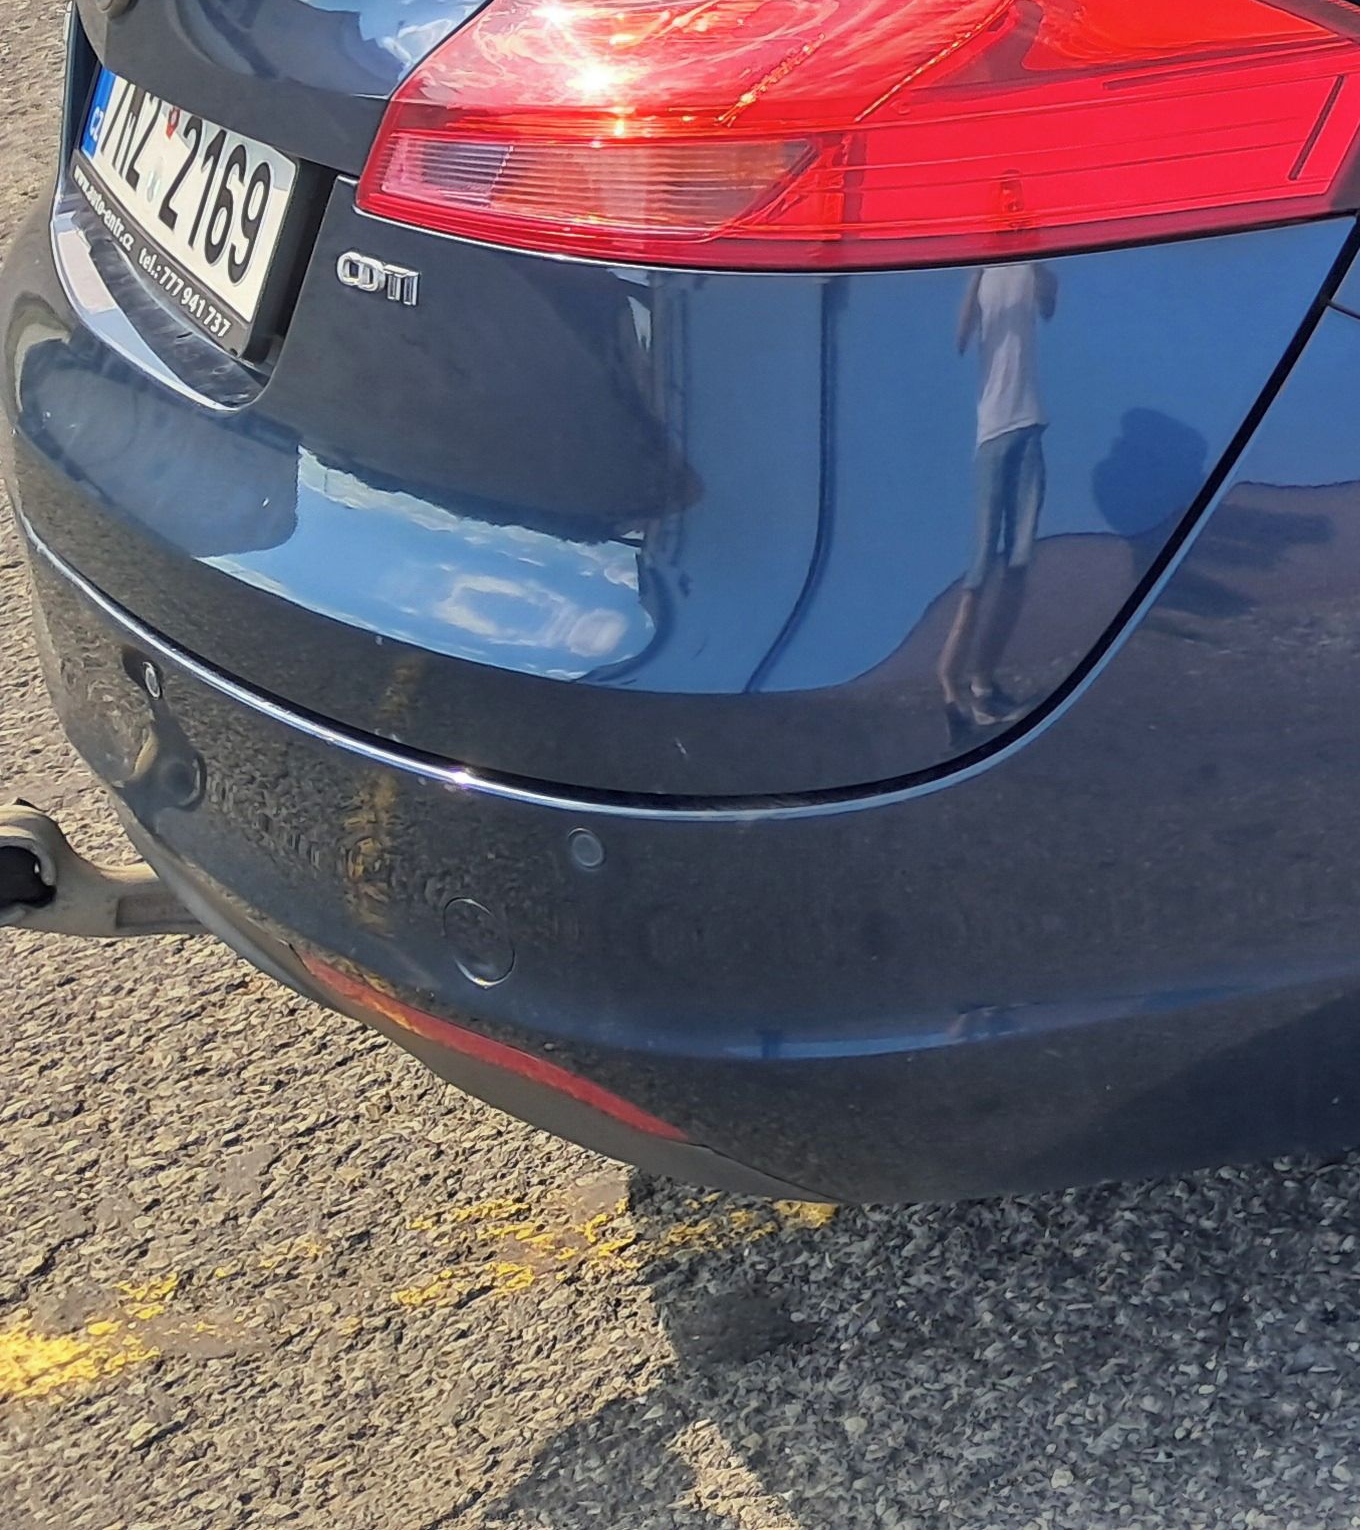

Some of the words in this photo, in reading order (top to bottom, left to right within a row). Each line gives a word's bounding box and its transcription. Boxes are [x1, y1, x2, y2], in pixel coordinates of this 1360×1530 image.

[158, 115, 271, 284] 2169
[337, 251, 419, 307] CDTI
[181, 287, 206, 318] 941
[203, 305, 231, 337] 737
